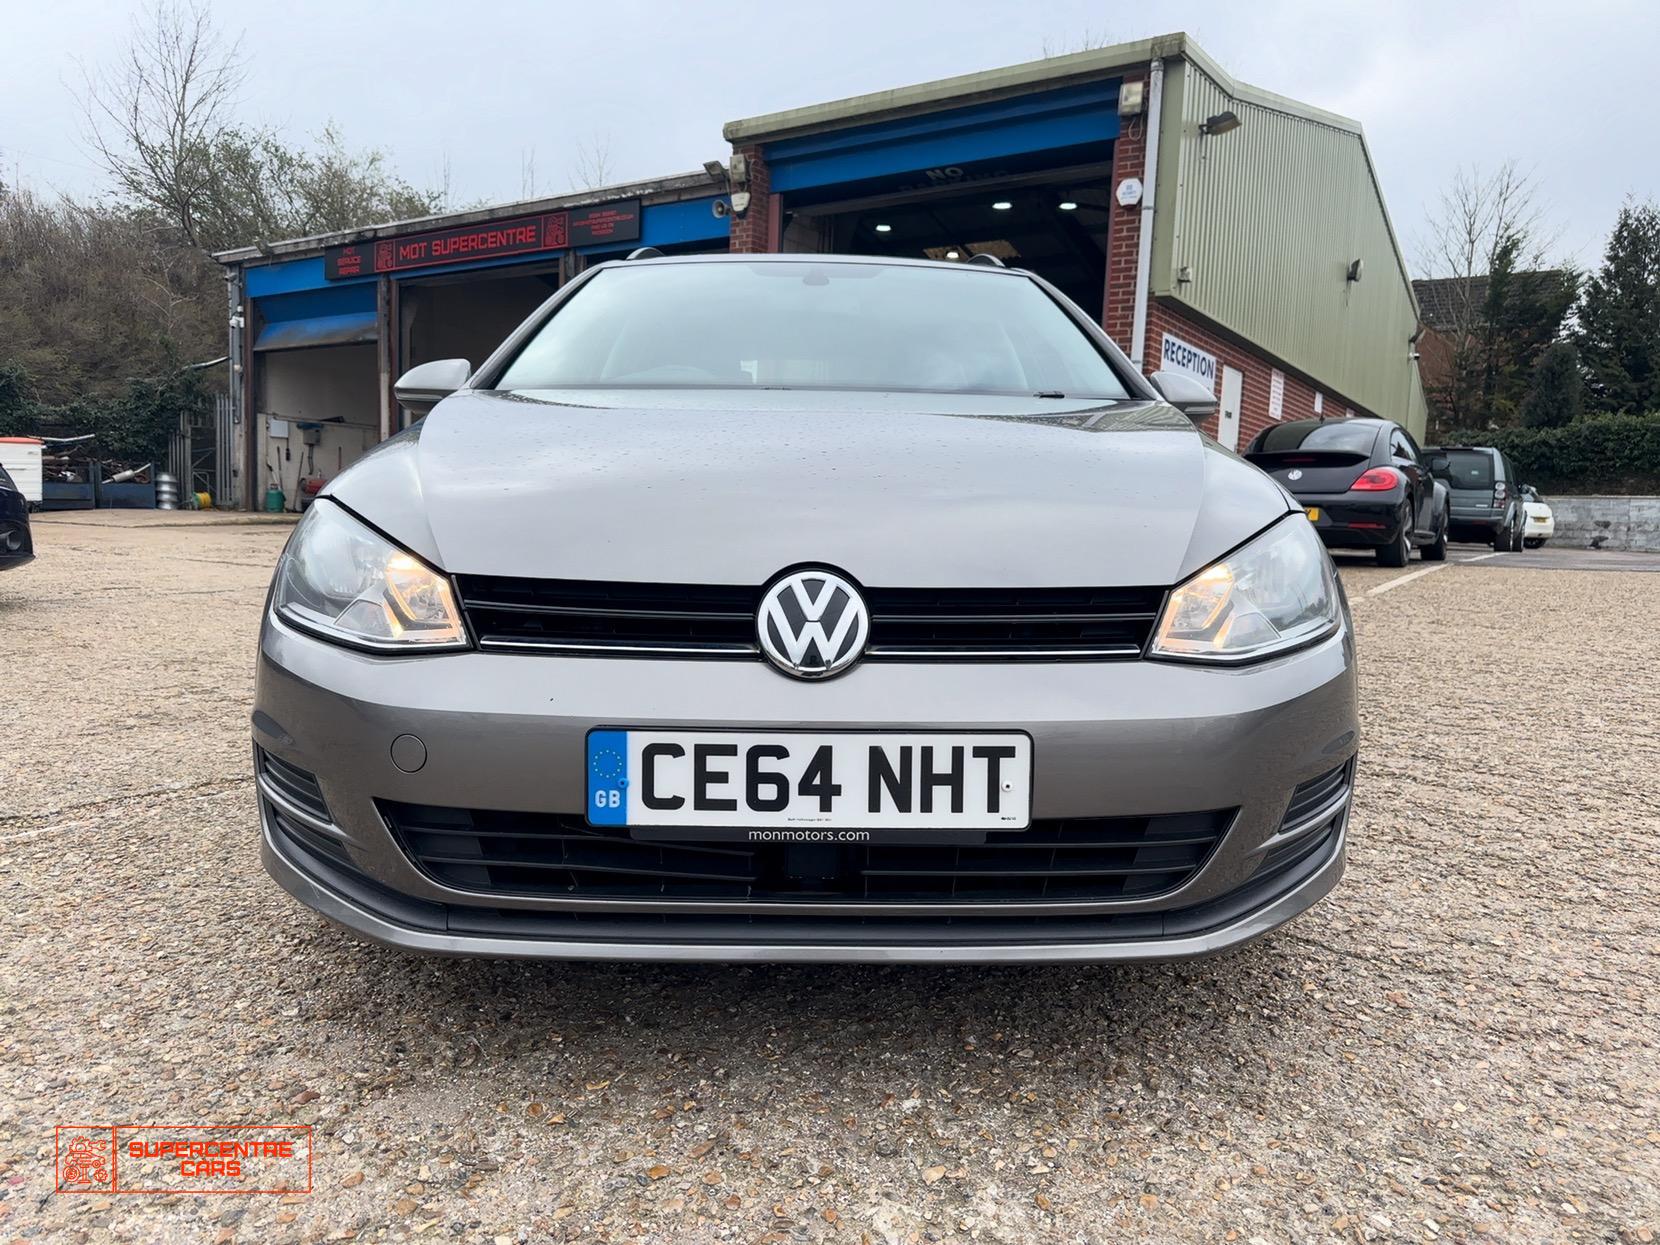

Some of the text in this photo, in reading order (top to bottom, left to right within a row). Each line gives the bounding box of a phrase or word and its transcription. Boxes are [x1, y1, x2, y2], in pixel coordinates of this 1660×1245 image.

[925, 167, 964, 180] NO
[400, 225, 537, 260] MOT SUPERCENTRE
[1164, 338, 1214, 379] RECEPTION
[641, 742, 1016, 813] CE64 NHT
[595, 790, 620, 808] GB
[748, 828, 871, 841] monmotors.com
